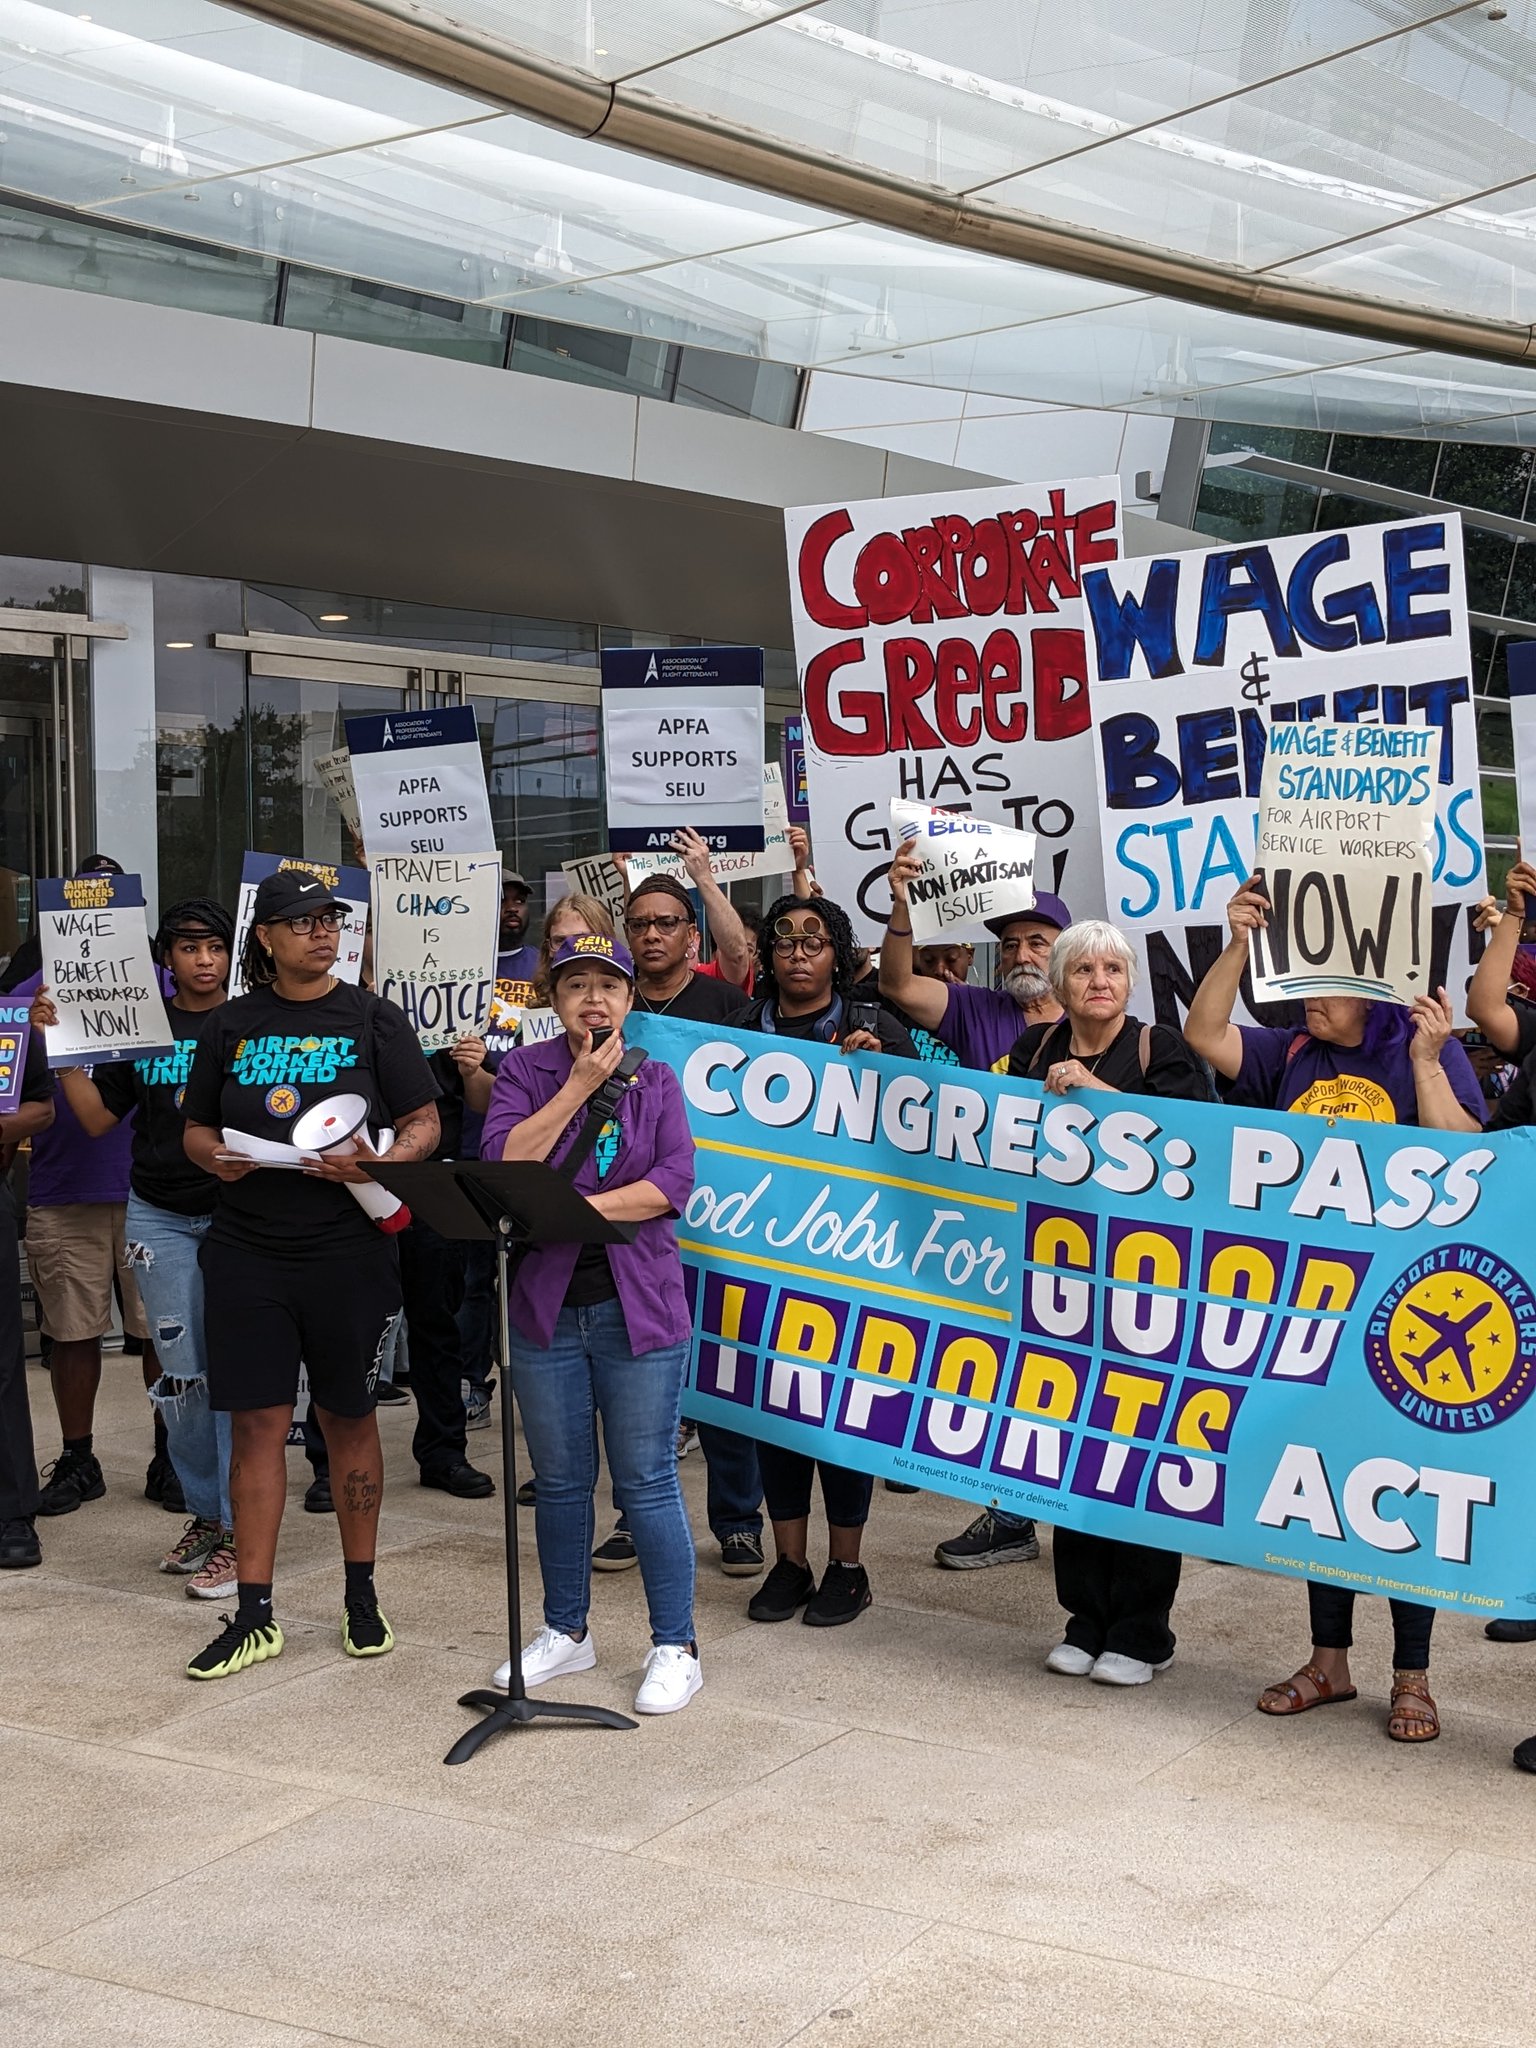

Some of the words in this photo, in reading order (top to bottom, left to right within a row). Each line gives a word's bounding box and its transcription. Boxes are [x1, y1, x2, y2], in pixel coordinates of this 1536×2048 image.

[1082, 523, 1452, 681] WAGE
[1240, 652, 1271, 705] &
[396, 726, 429, 734] PROFESSIONAL
[412, 731, 442, 739] ATTENDANTS
[658, 718, 710, 735] APFA
[1270, 725, 1338, 757] WAGE
[1354, 727, 1436, 758] BENEFIT
[631, 750, 738, 767] SUPPORTS
[398, 776, 441, 796] APFA
[899, 752, 1010, 800] HAS
[1278, 764, 1431, 806] STANDARDS
[665, 782, 705, 797] SEIU
[379, 805, 468, 828] SUPPORTS
[928, 820, 993, 837] BLUE
[1002, 796, 1075, 838] TO
[1267, 807, 1293, 825] FOR
[1299, 808, 1390, 832] AIRPORT
[410, 838, 444, 854] SEIU
[975, 847, 988, 860] A
[1262, 832, 1329, 855] SERVICE
[1340, 838, 1417, 860] WORKERS
[377, 858, 471, 883] TRAVEL
[628, 858, 653, 870] This
[67, 878, 111, 889] AIRPORT
[565, 860, 623, 897] THE
[63, 887, 115, 900] WORKERS
[70, 898, 109, 909] UNITED
[396, 893, 470, 916] CHAOS
[935, 891, 994, 927] ISSUE
[52, 913, 116, 937] WAGE
[423, 928, 440, 943] IS
[1254, 867, 1423, 981] NOW!
[574, 942, 614, 957] Texas
[577, 935, 613, 947] SEIU
[54, 956, 135, 985] BENEFIT
[423, 953, 439, 969] A
[80, 1005, 140, 1038] NOW!
[241, 1034, 355, 1058] AIRPORT
[231, 1051, 359, 1073] WORKERS
[238, 1065, 336, 1085] UNITED
[1339, 1078, 1385, 1107] WORKERS
[683, 1041, 1196, 1200] CONGRESS:
[1320, 1102, 1359, 1115] FIGHT
[1228, 1126, 1496, 1230] PASS
[765, 1184, 904, 1269] Jobs
[912, 1209, 1010, 1295] For
[1032, 1216, 1356, 1376] GOOD
[1369, 1249, 1450, 1336] AIRPORT
[1457, 1247, 1536, 1356] WORKERS
[716, 1284, 1232, 1513] IRPORTS
[1399, 1390, 1495, 1428] UNITED
[893, 1456, 910, 1469] Not
[909, 1463, 914, 1471] a
[916, 1465, 948, 1481] request
[949, 1472, 958, 1482] to
[959, 1474, 980, 1489] stop
[980, 1480, 1014, 1497] services
[1015, 1487, 1026, 1498] or
[1026, 1491, 1070, 1512] deliveries.
[1255, 1443, 1496, 1565] ACT
[1264, 1552, 1306, 1570] Service
[1308, 1561, 1374, 1584] Employees
[1376, 1575, 1459, 1602] International
[1461, 1592, 1505, 1609] Union
